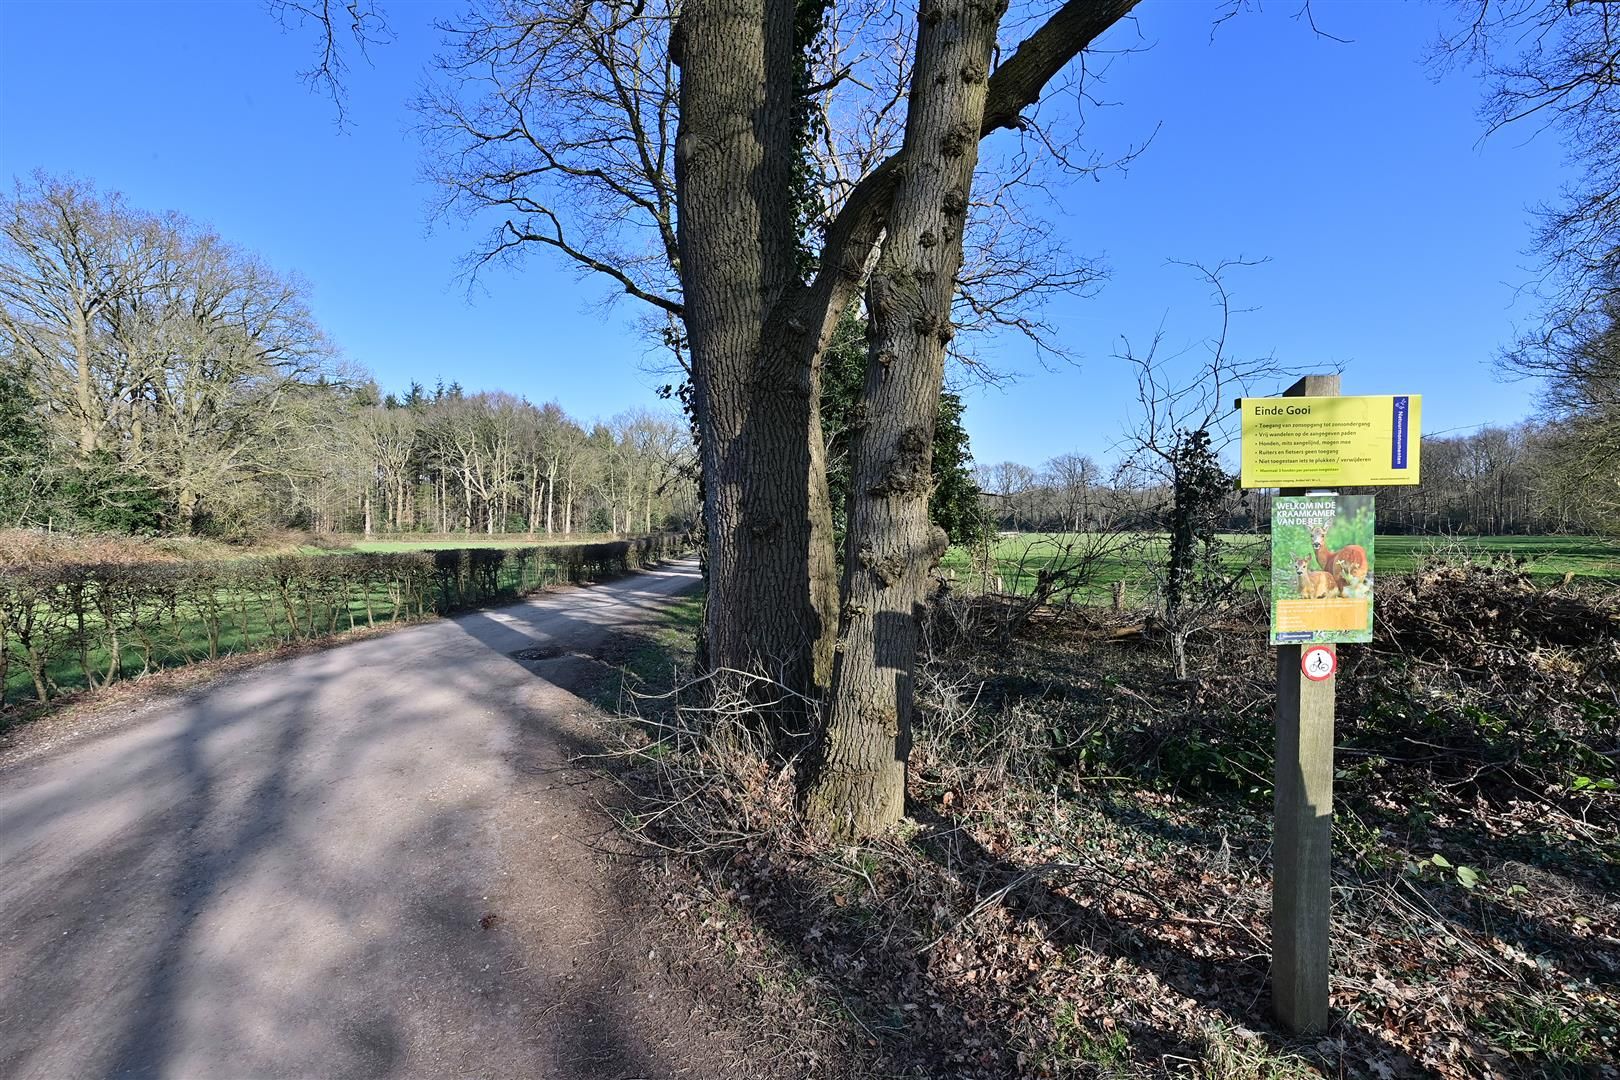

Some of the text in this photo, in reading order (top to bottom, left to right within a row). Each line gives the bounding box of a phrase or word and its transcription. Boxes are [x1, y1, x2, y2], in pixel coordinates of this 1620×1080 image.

[1255, 405, 1311, 416] Einde Gooi
[1276, 502, 1313, 510] WELKOM
[1325, 501, 1336, 509] DE
[1308, 517, 1323, 525] REE
